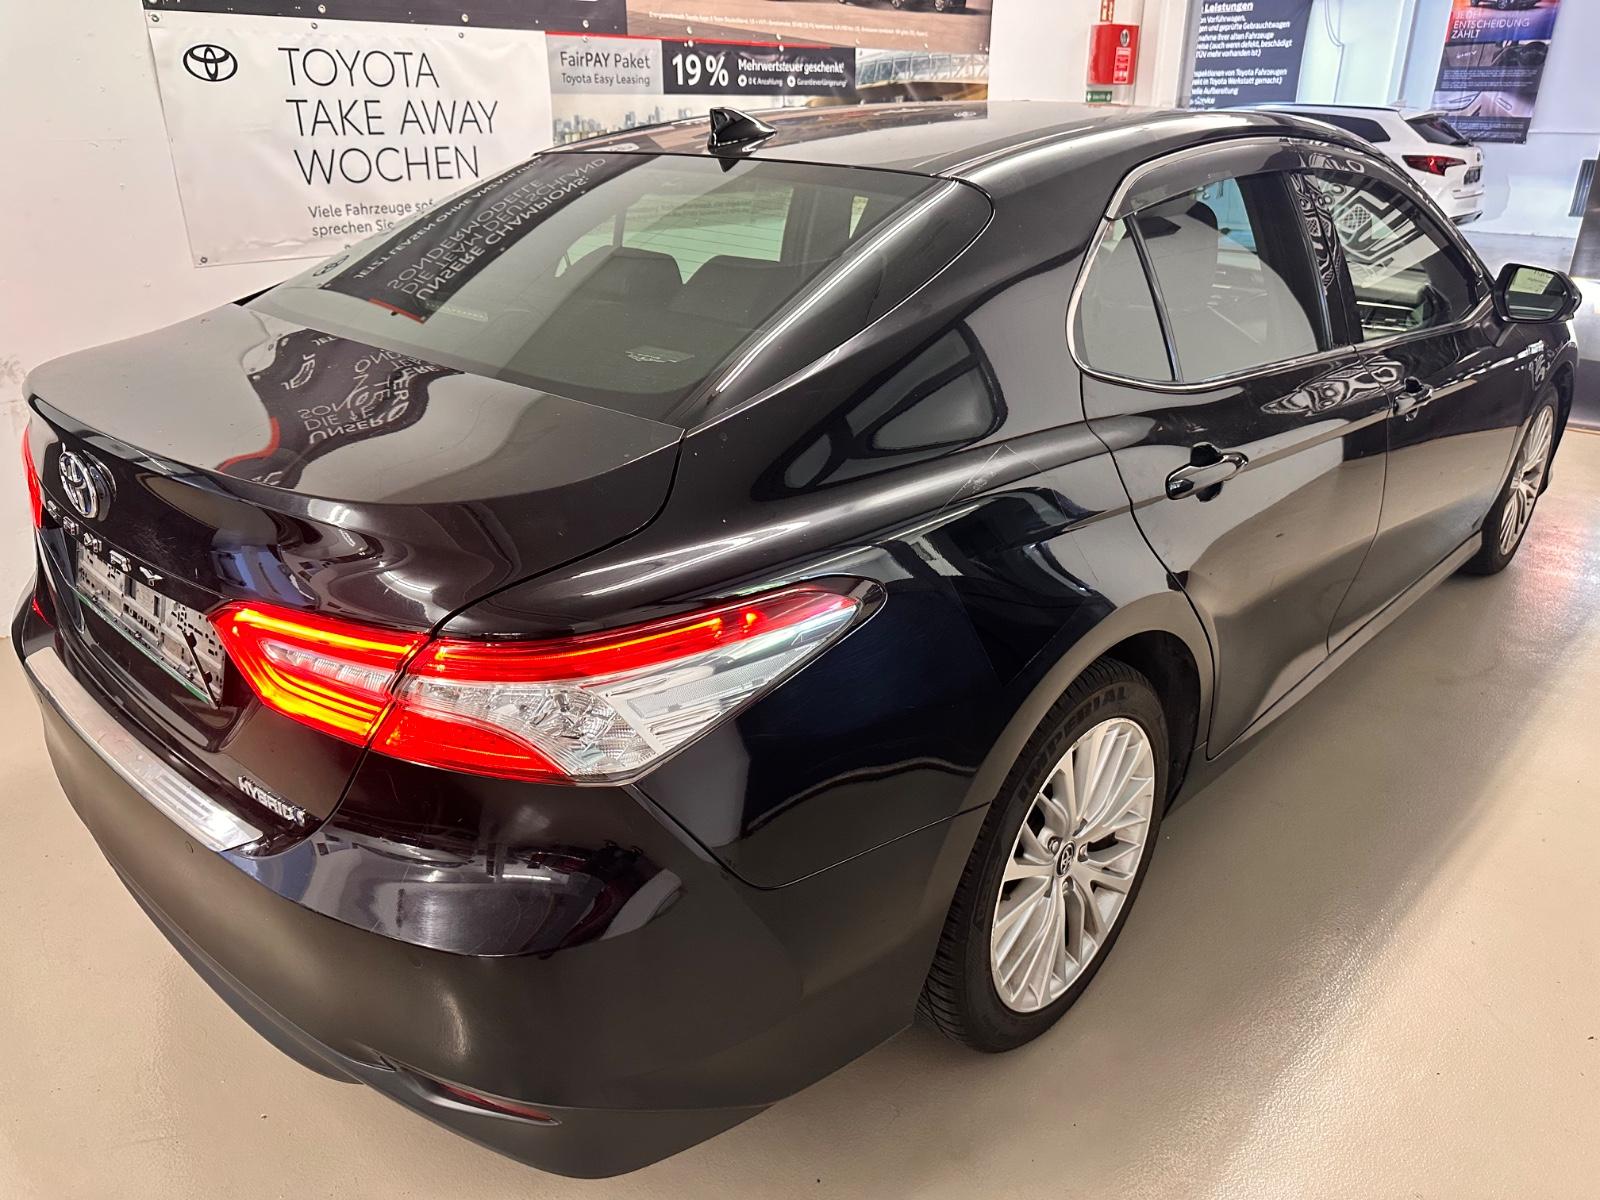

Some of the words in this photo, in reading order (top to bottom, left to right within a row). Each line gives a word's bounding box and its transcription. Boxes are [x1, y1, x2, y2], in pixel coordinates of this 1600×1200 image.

[1204, 2, 1254, 13] Leistungen
[1453, 18, 1530, 29] ENTSCHEIDUNG
[278, 47, 439, 88] TOYOTA
[560, 51, 610, 68] FairPAY
[614, 52, 651, 69] Paket
[738, 59, 803, 73] Mehrwertsteuer
[672, 54, 701, 86] 19
[705, 55, 729, 87] %
[1236, 68, 1254, 77] Toyota
[561, 73, 592, 86] Toyota
[594, 74, 614, 87] Easy
[616, 74, 650, 87] Leasing
[1209, 77, 1227, 86] Toyota
[285, 99, 385, 136] TAKE
[400, 100, 498, 135] AWAY
[294, 145, 479, 185] WOCHEN
[308, 203, 343, 219] Viele
[345, 200, 412, 216] Fahrzeuge
[312, 221, 373, 238] sprechen
[1017, 685, 1127, 801] IMPERIAL
